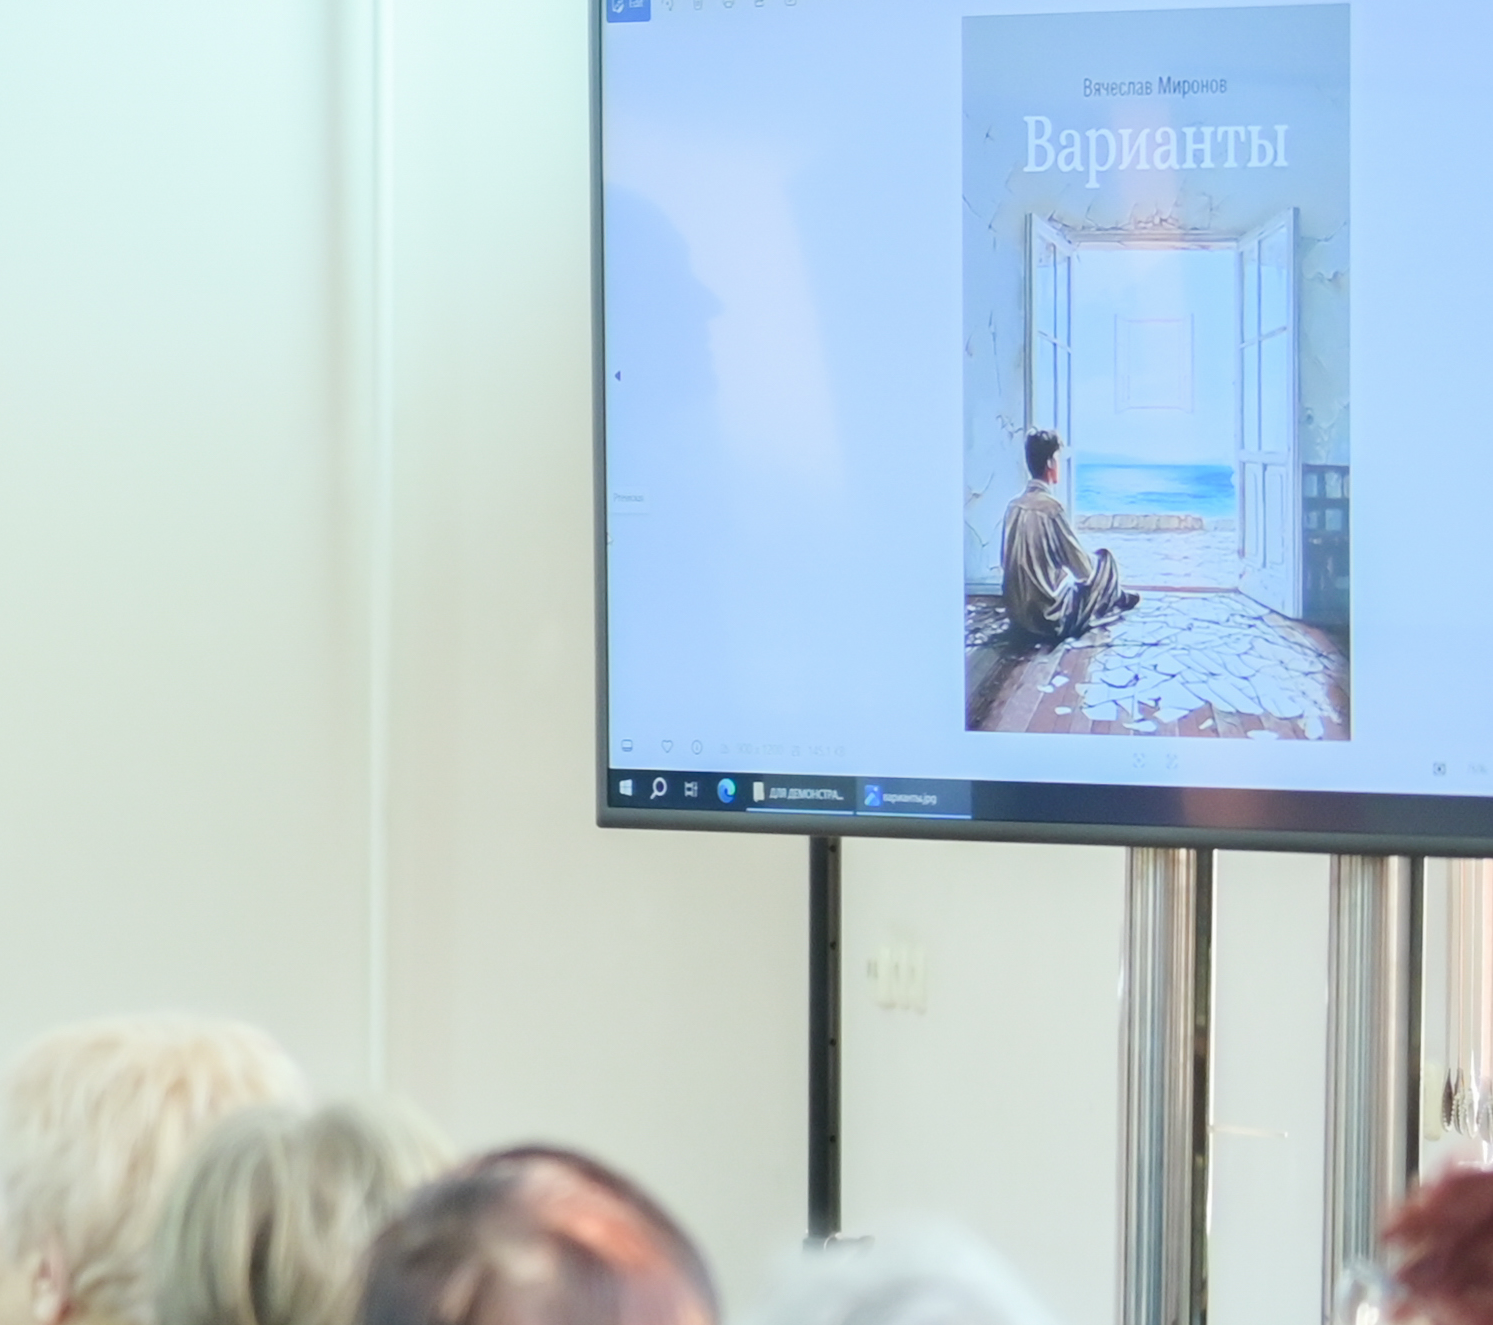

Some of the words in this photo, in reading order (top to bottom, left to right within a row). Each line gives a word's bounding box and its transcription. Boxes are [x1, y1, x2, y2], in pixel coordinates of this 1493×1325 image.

[1083, 78, 1152, 98] Вячеслав
[1157, 76, 1228, 98] Миронов
[1023, 115, 1289, 189] Варианты
[769, 787, 786, 799] ДЛЯ
